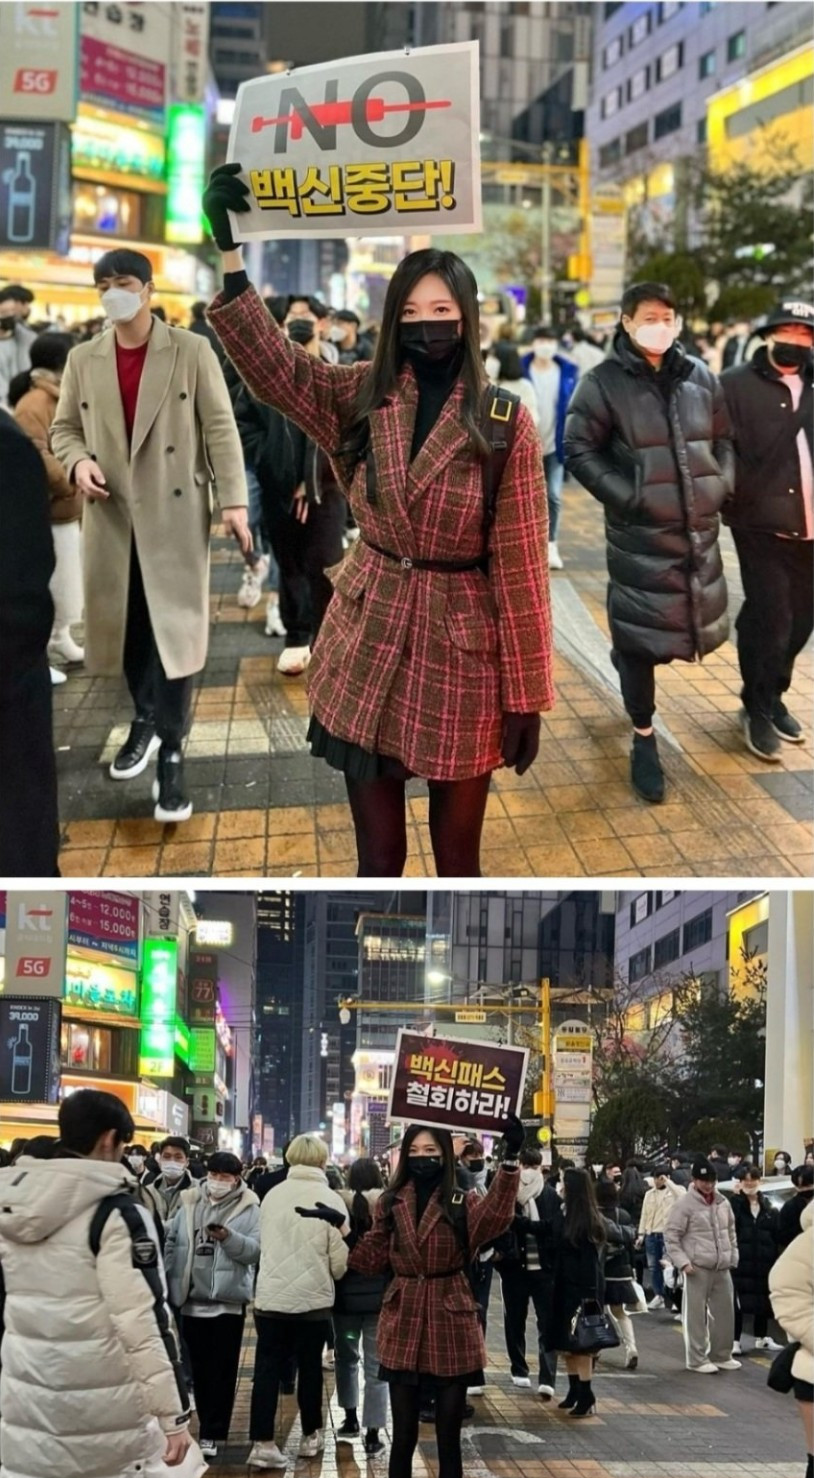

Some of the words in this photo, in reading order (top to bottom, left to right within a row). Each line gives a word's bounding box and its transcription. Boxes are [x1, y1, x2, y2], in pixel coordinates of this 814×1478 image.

[21, 71, 50, 92] 5G
[274, 71, 426, 154] NO
[249, 159, 457, 218] 백신중단!
[18, 903, 53, 931] kt
[22, 960, 45, 975] 5G
[409, 1053, 507, 1092] 백신패스
[406, 1081, 511, 1120] 철회하라!
